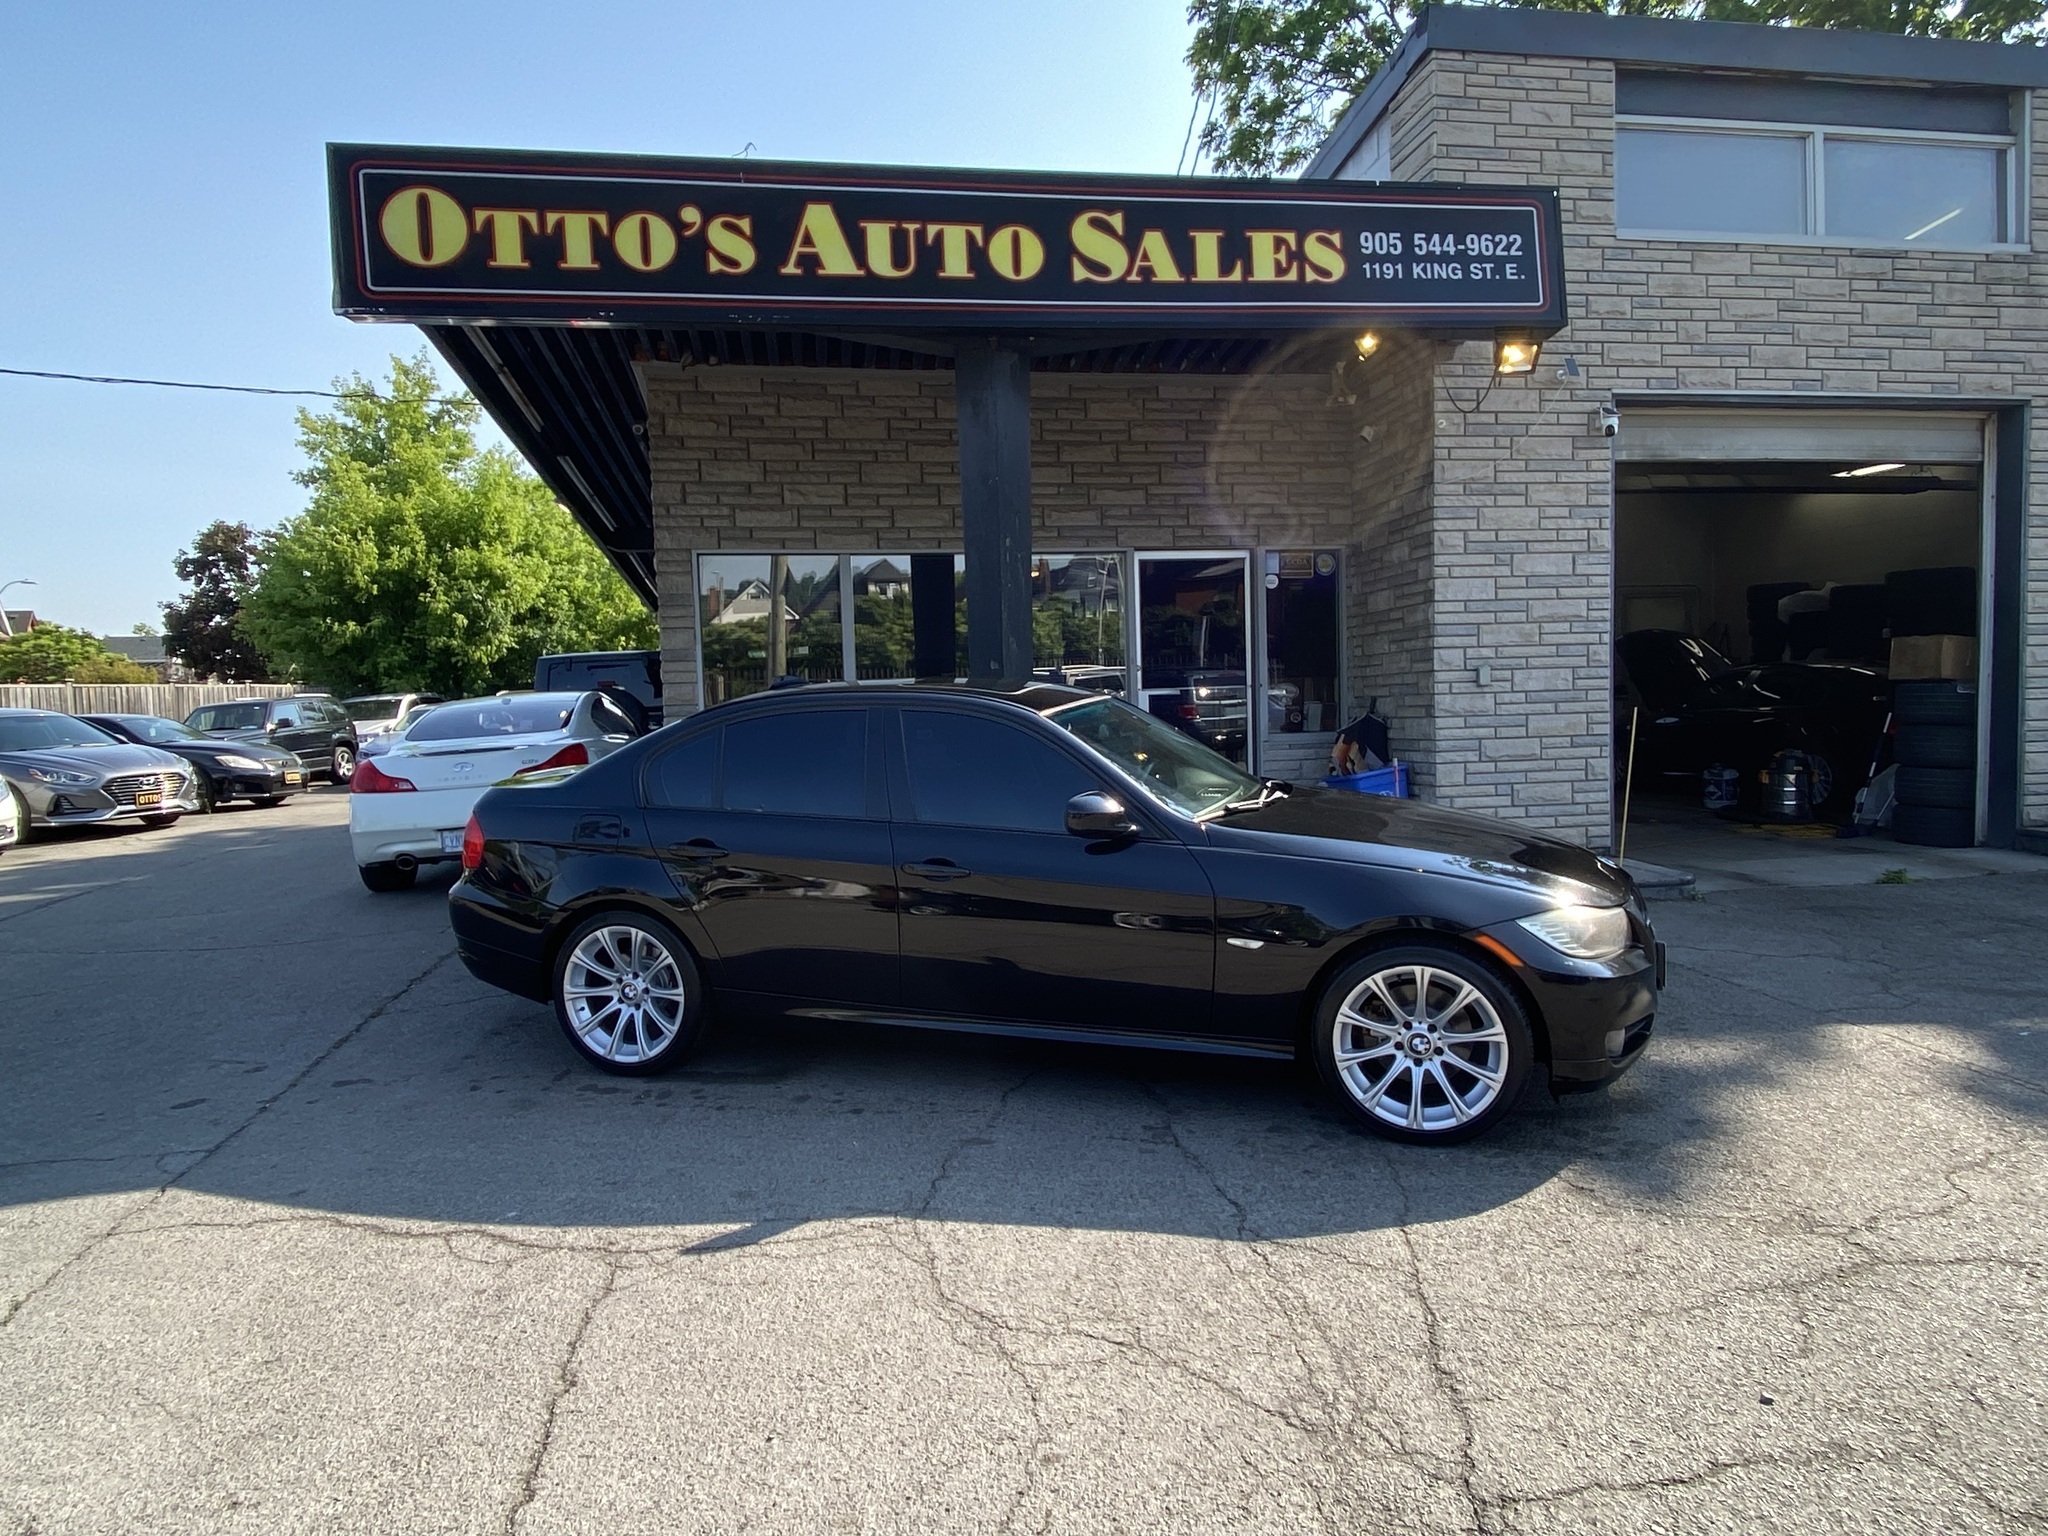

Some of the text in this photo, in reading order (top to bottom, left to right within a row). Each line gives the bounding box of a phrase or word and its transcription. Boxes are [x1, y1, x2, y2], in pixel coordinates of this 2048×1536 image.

[379, 186, 1347, 284] OTTO'S AUTO SALES
[1359, 231, 1523, 256] 905 544-9622
[1362, 262, 1526, 280] 1191 KING ST. E.
